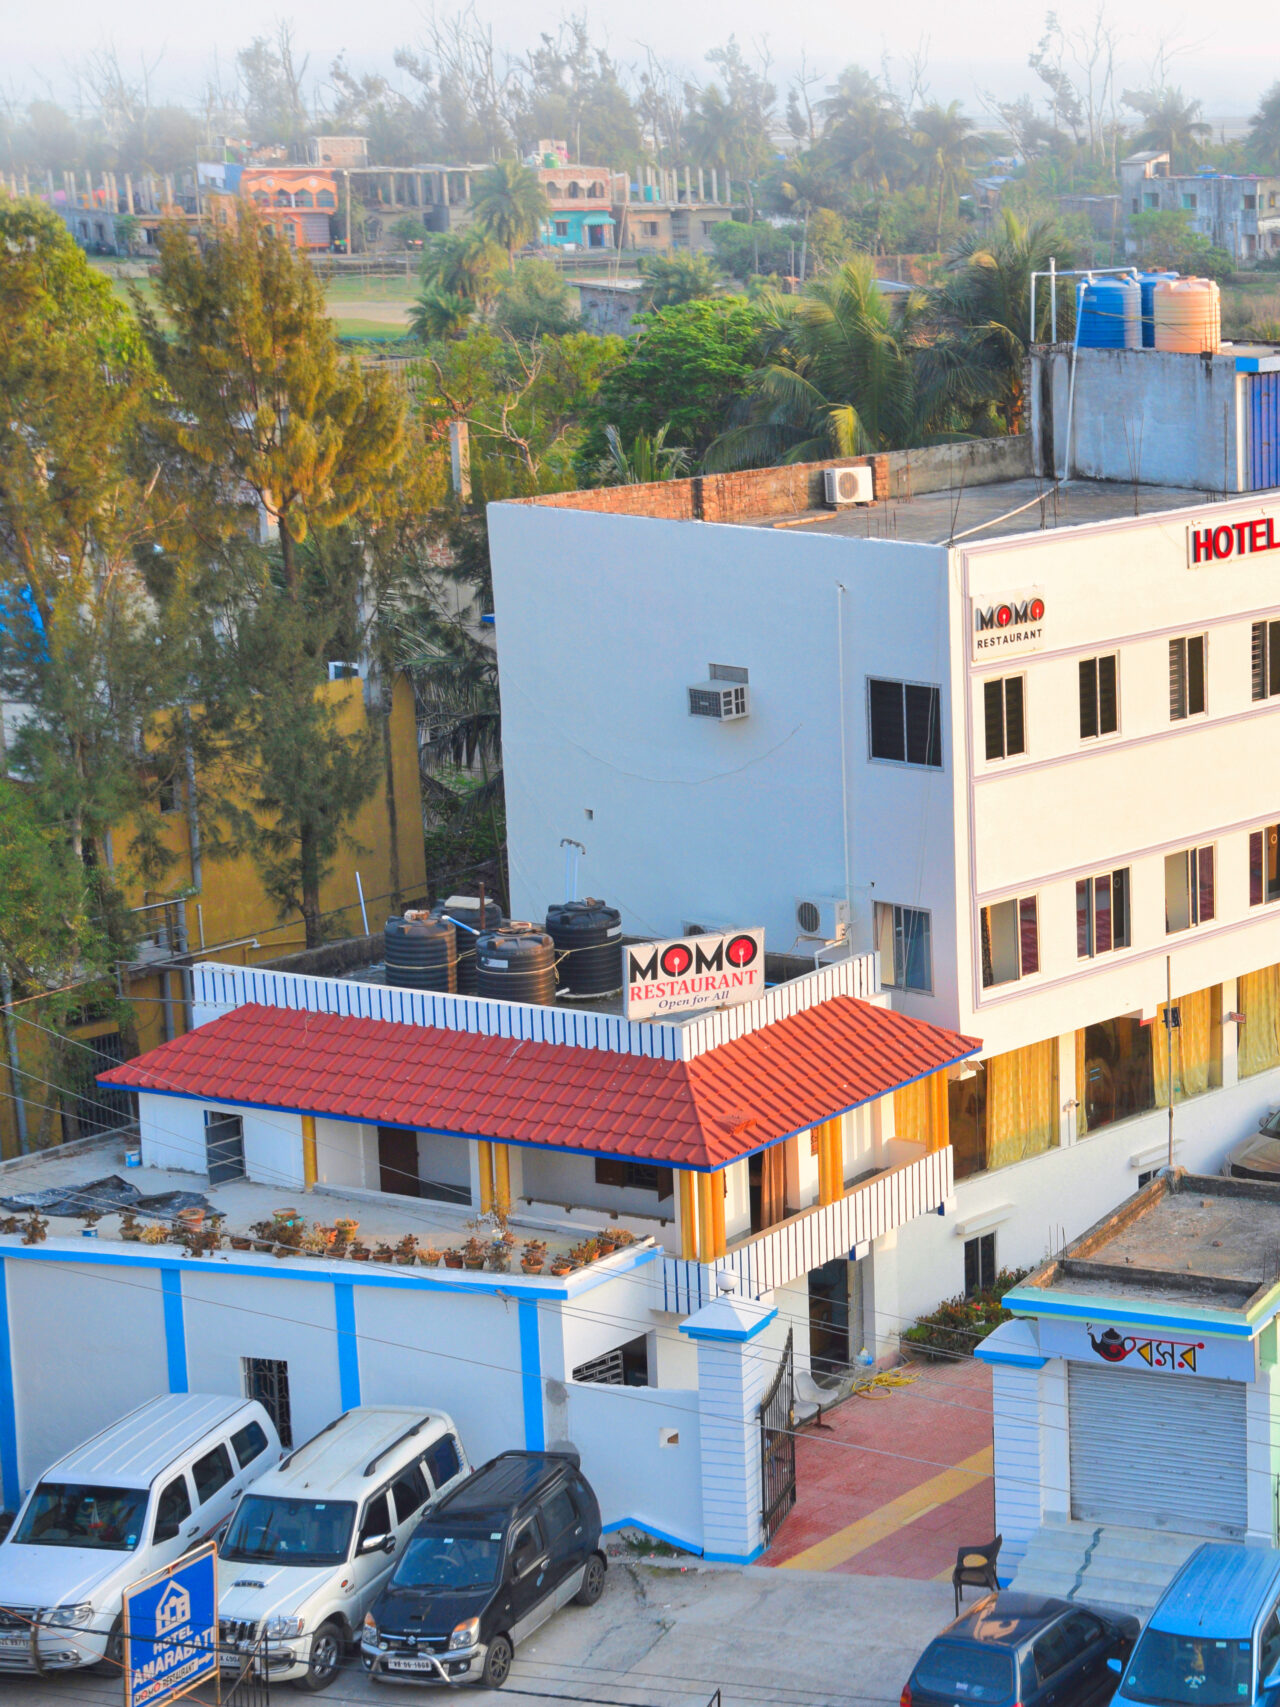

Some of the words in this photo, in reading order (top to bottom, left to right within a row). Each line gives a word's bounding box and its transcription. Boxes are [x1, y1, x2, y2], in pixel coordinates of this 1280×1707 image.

[975, 597, 1045, 631] MOMO
[977, 629, 1042, 649] RESTAURANT
[629, 934, 757, 983] MOMO
[630, 969, 758, 1001] RESTAURANT
[658, 996, 689, 1010] Open
[691, 994, 710, 1007] for
[712, 990, 730, 1001] All
[153, 1625, 194, 1655] HOTEL
[133, 1626, 214, 1689] AMARABATI
[162, 1661, 196, 1688] RESTAURANT
